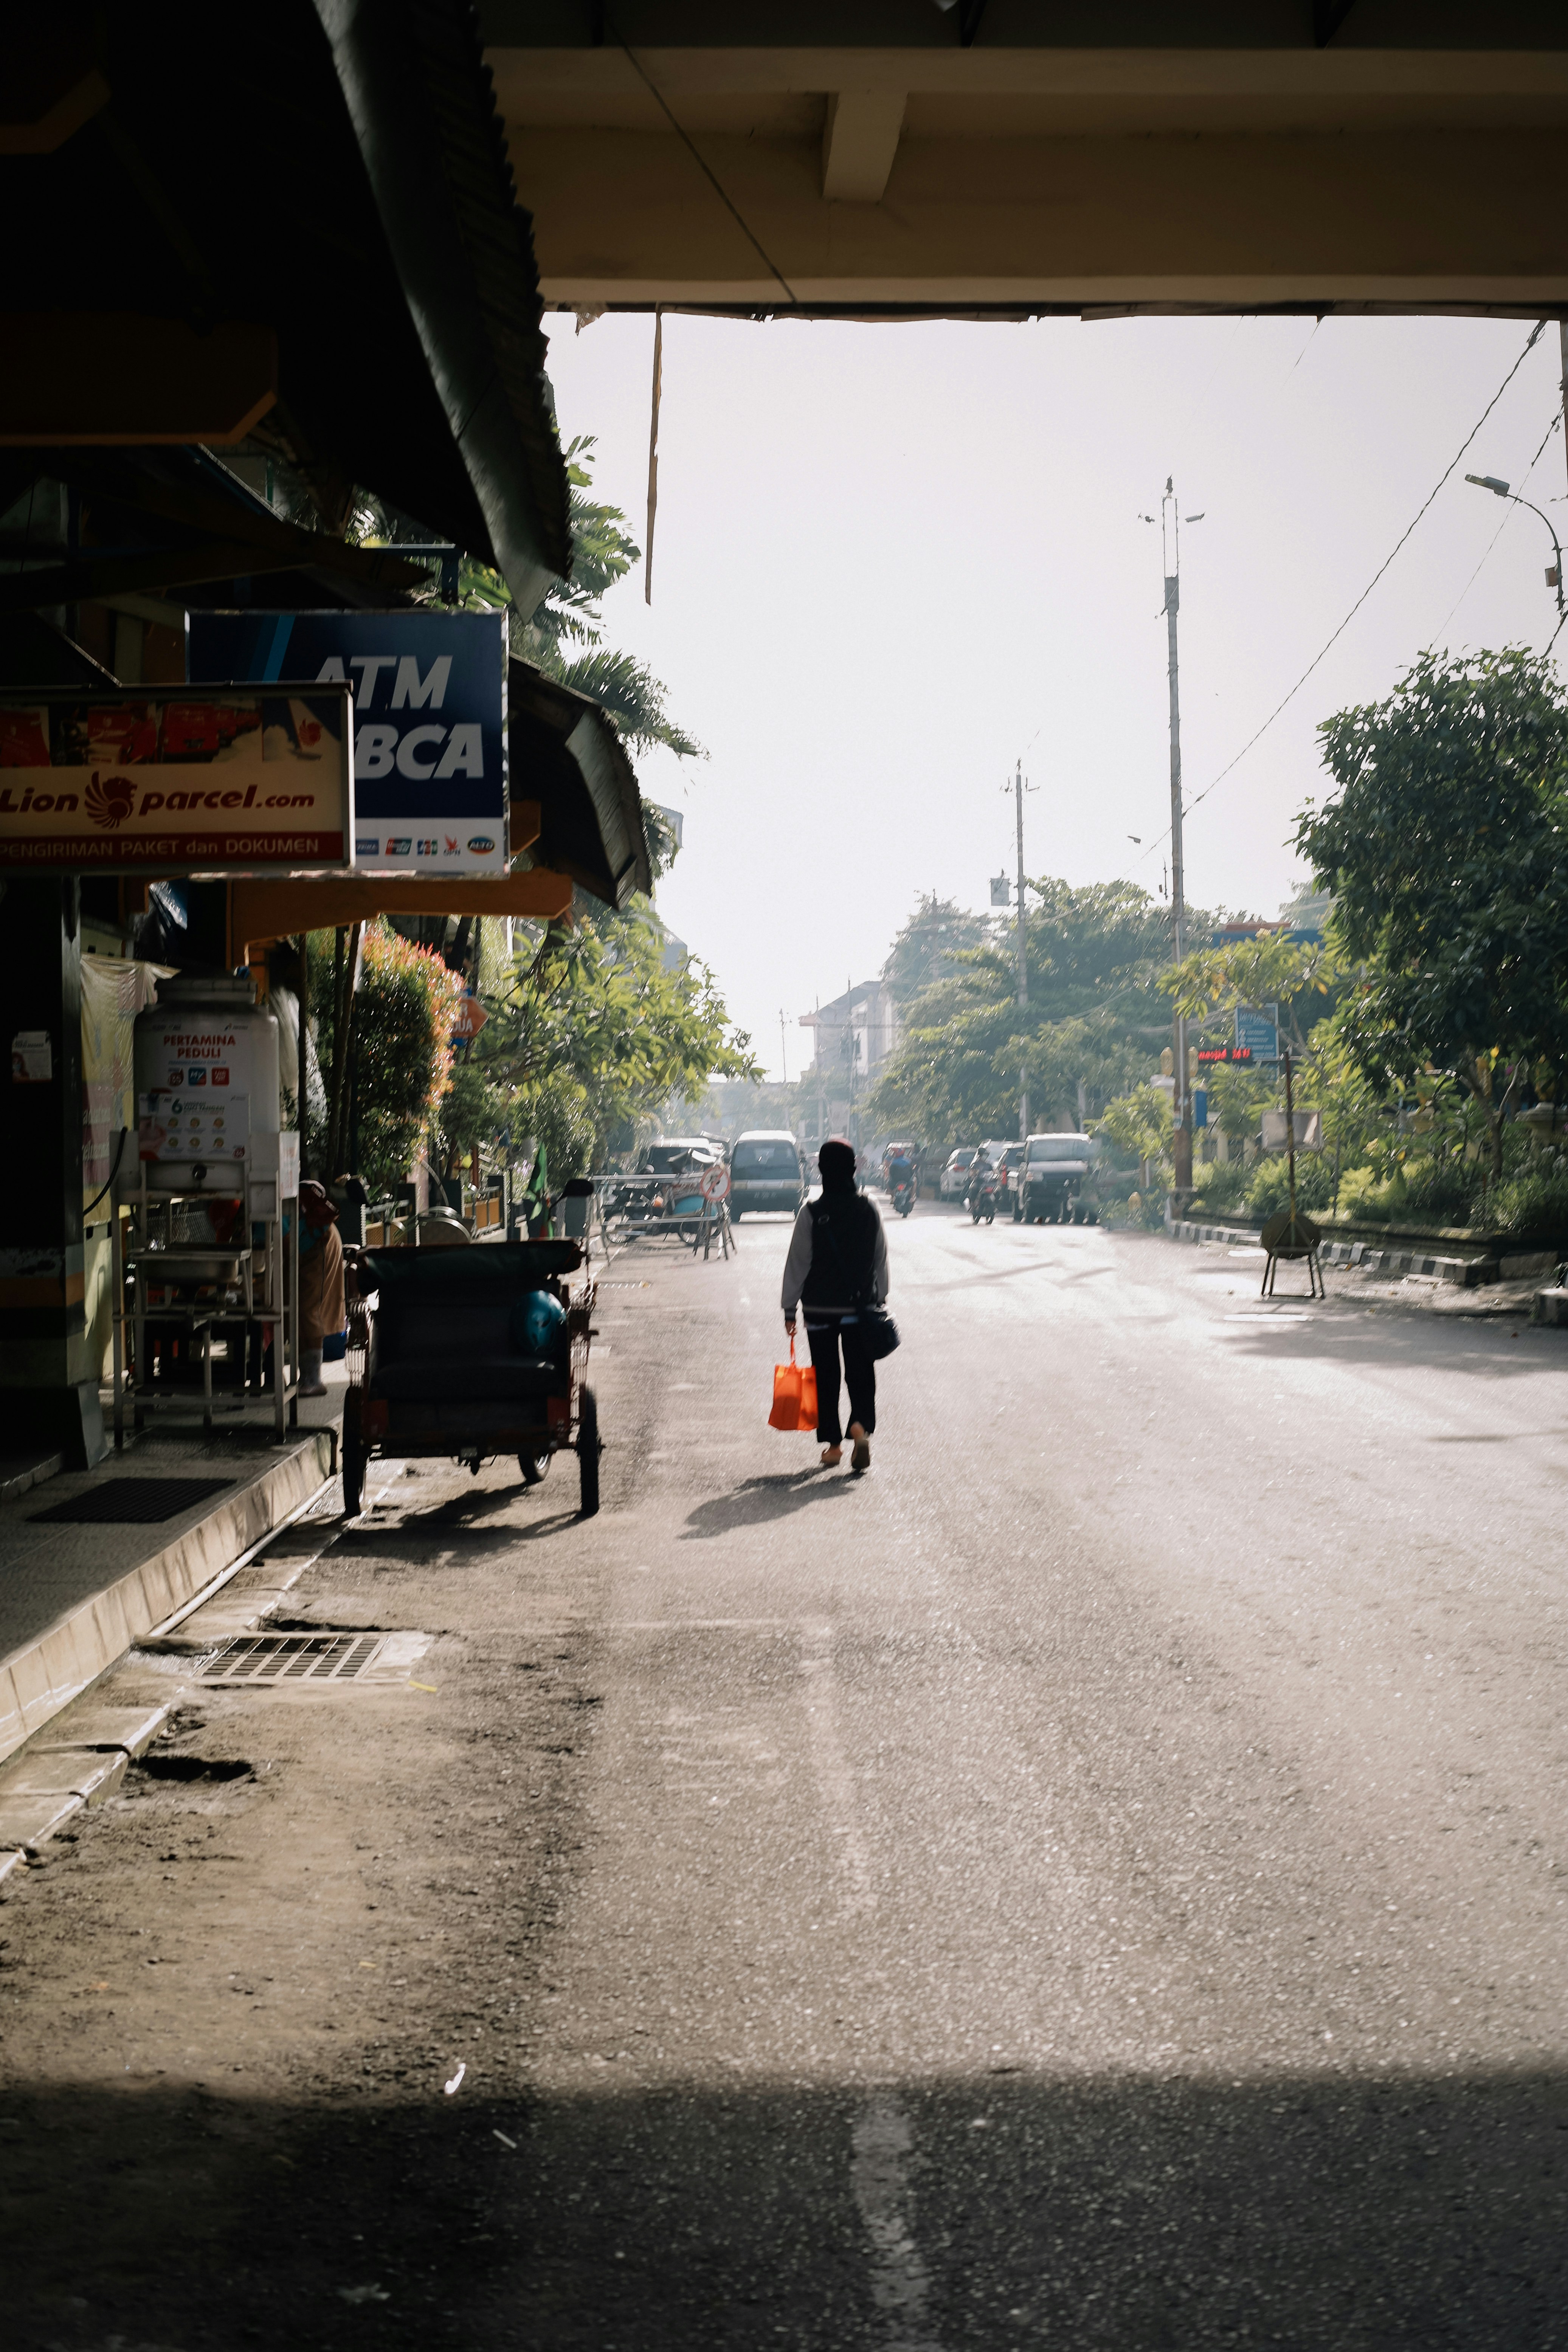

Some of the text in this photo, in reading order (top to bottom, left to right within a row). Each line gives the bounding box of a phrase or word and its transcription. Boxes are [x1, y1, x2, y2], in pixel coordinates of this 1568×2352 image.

[354, 723, 484, 781] BCA
[0, 783, 315, 817] Lion parcel.com
[0, 838, 319, 859] PENGIRIMAN PAKET dan DOKUMEN
[469, 841, 493, 850] ALTO
[163, 1034, 236, 1047] PERTAMINA
[177, 1047, 221, 1059] PEDULI
[171, 1098, 183, 1115] 6
